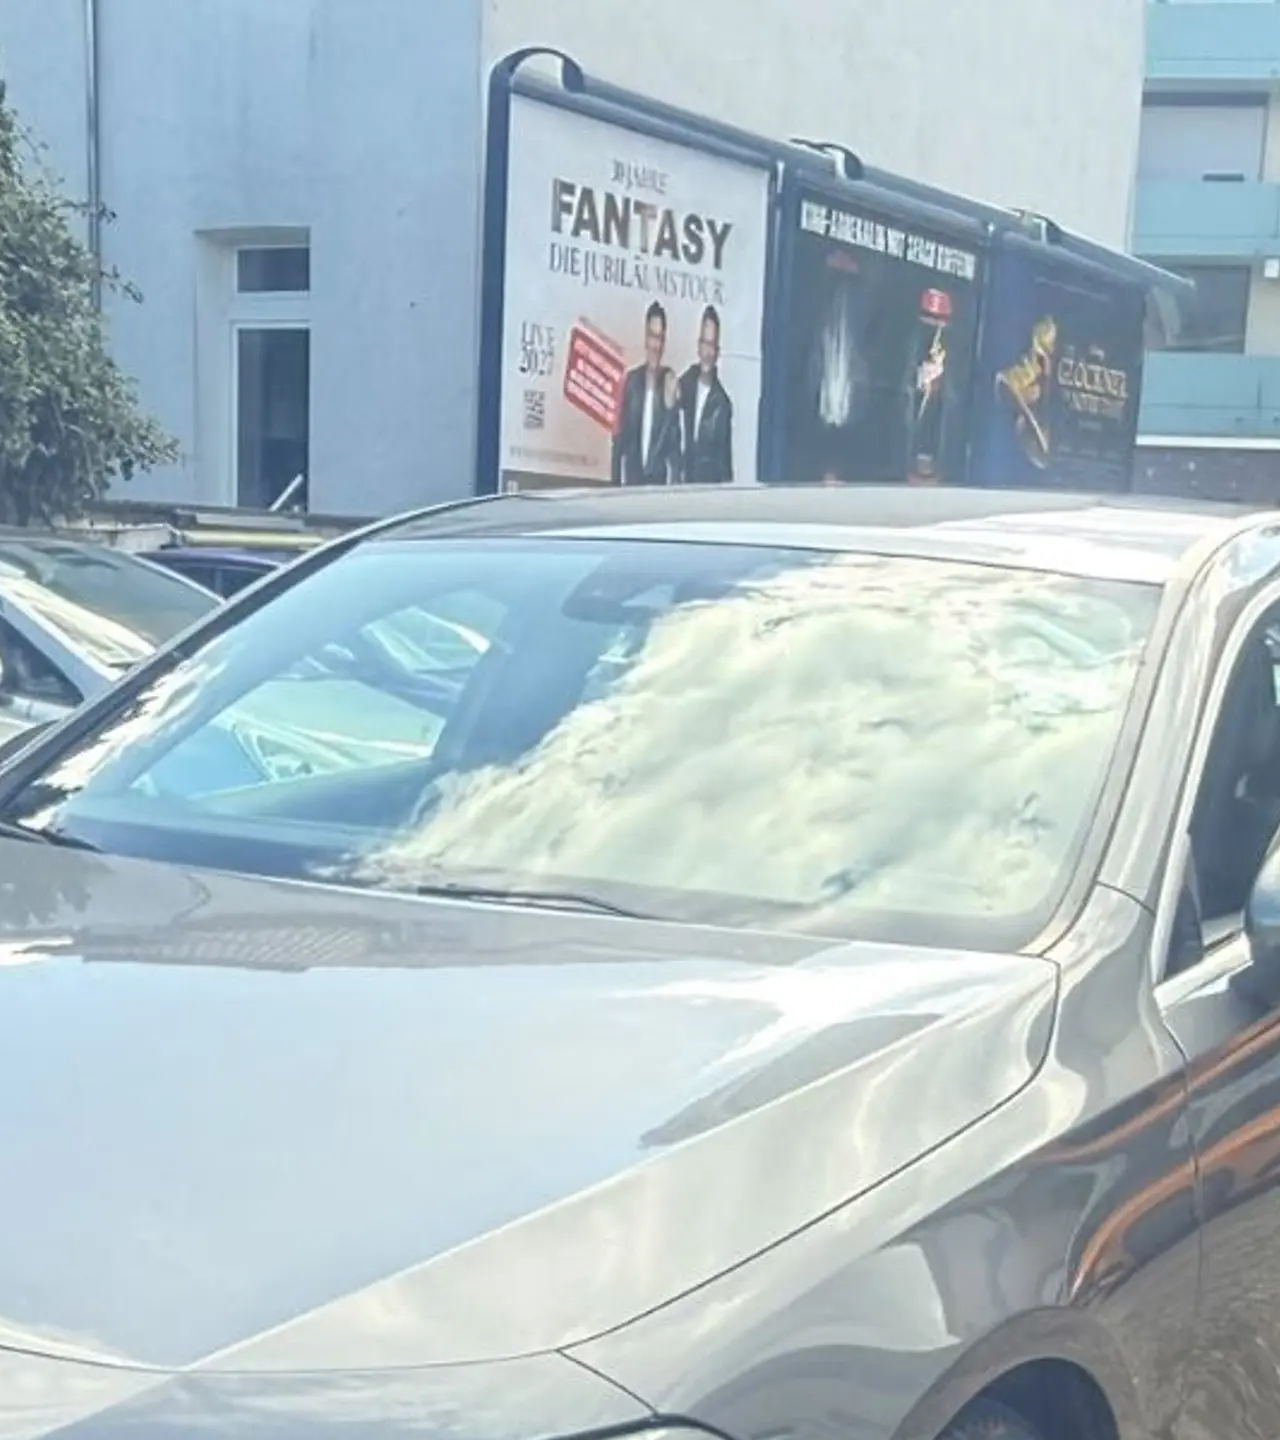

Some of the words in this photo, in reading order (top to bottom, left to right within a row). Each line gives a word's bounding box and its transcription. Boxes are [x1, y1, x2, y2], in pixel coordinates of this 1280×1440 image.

[551, 177, 733, 270] FANTASY
[549, 242, 581, 277] DIE
[521, 320, 555, 355] LIVE
